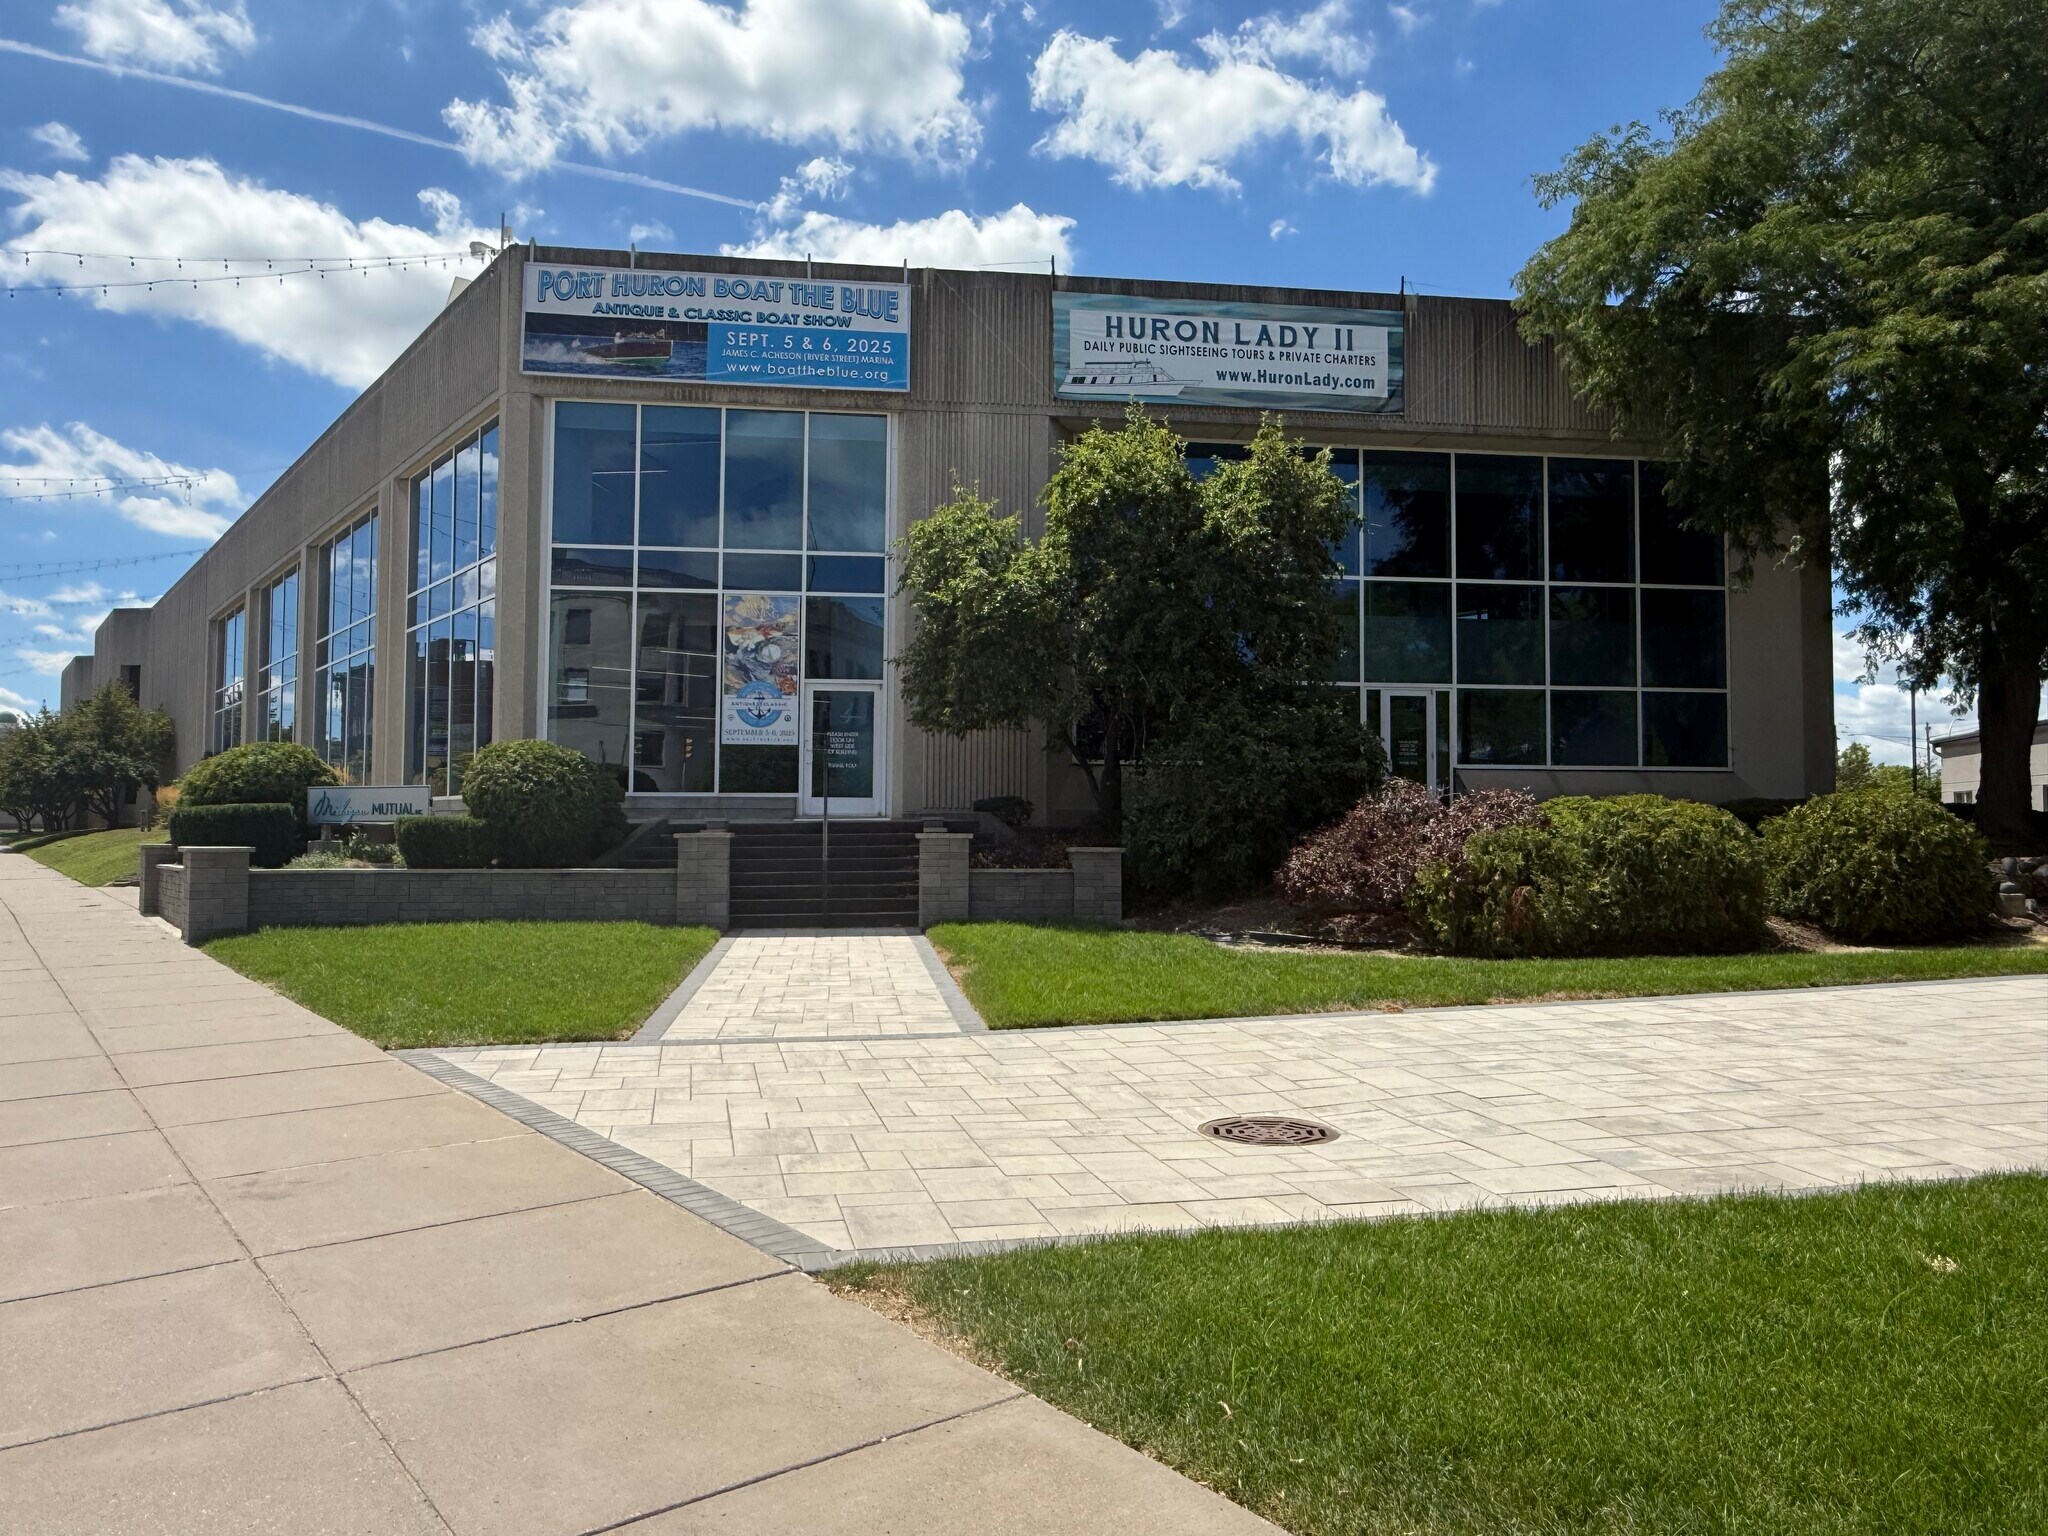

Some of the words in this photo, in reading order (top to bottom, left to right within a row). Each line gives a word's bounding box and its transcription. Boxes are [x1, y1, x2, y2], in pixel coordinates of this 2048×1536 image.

[537, 269, 606, 302] PORT
[611, 273, 706, 298] HURON
[713, 277, 784, 303] BOAT
[788, 282, 835, 310] THE
[840, 286, 899, 322] BLUE
[592, 302, 665, 318] ANTIQUE
[667, 306, 680, 319] &
[684, 307, 752, 323] CLASSIC
[756, 311, 800, 326] BOAT
[802, 314, 853, 328] SHOW
[726, 331, 775, 348] SEPT.
[783, 335, 794, 349] 5
[802, 337, 813, 350] &
[822, 337, 839, 353] 6,
[847, 338, 892, 354] 2025
[1105, 315, 1220, 345] HURON
[1234, 322, 1320, 350] LADY
[1334, 327, 1354, 352] II
[721, 348, 749, 358] JAMES
[750, 350, 760, 358] C.
[761, 351, 802, 360] ACHESON
[803, 353, 830, 362] (RIVER
[831, 354, 860, 364] STREET)
[860, 356, 895, 365] MARINA
[1083, 340, 1116, 353] DAILY
[1119, 341, 1156, 355] PUBLIC
[1159, 343, 1229, 360] SIGHTSEEING
[1231, 347, 1265, 361] TOURS
[1268, 350, 1276, 362] &
[1278, 350, 1321, 364] PRIVATE
[1324, 352, 1377, 367] CHARTERS
[726, 363, 889, 382] www.boattheblue.org
[1215, 368, 1376, 390] www.HuronLady.com
[371, 802, 416, 816] MUTUAL
